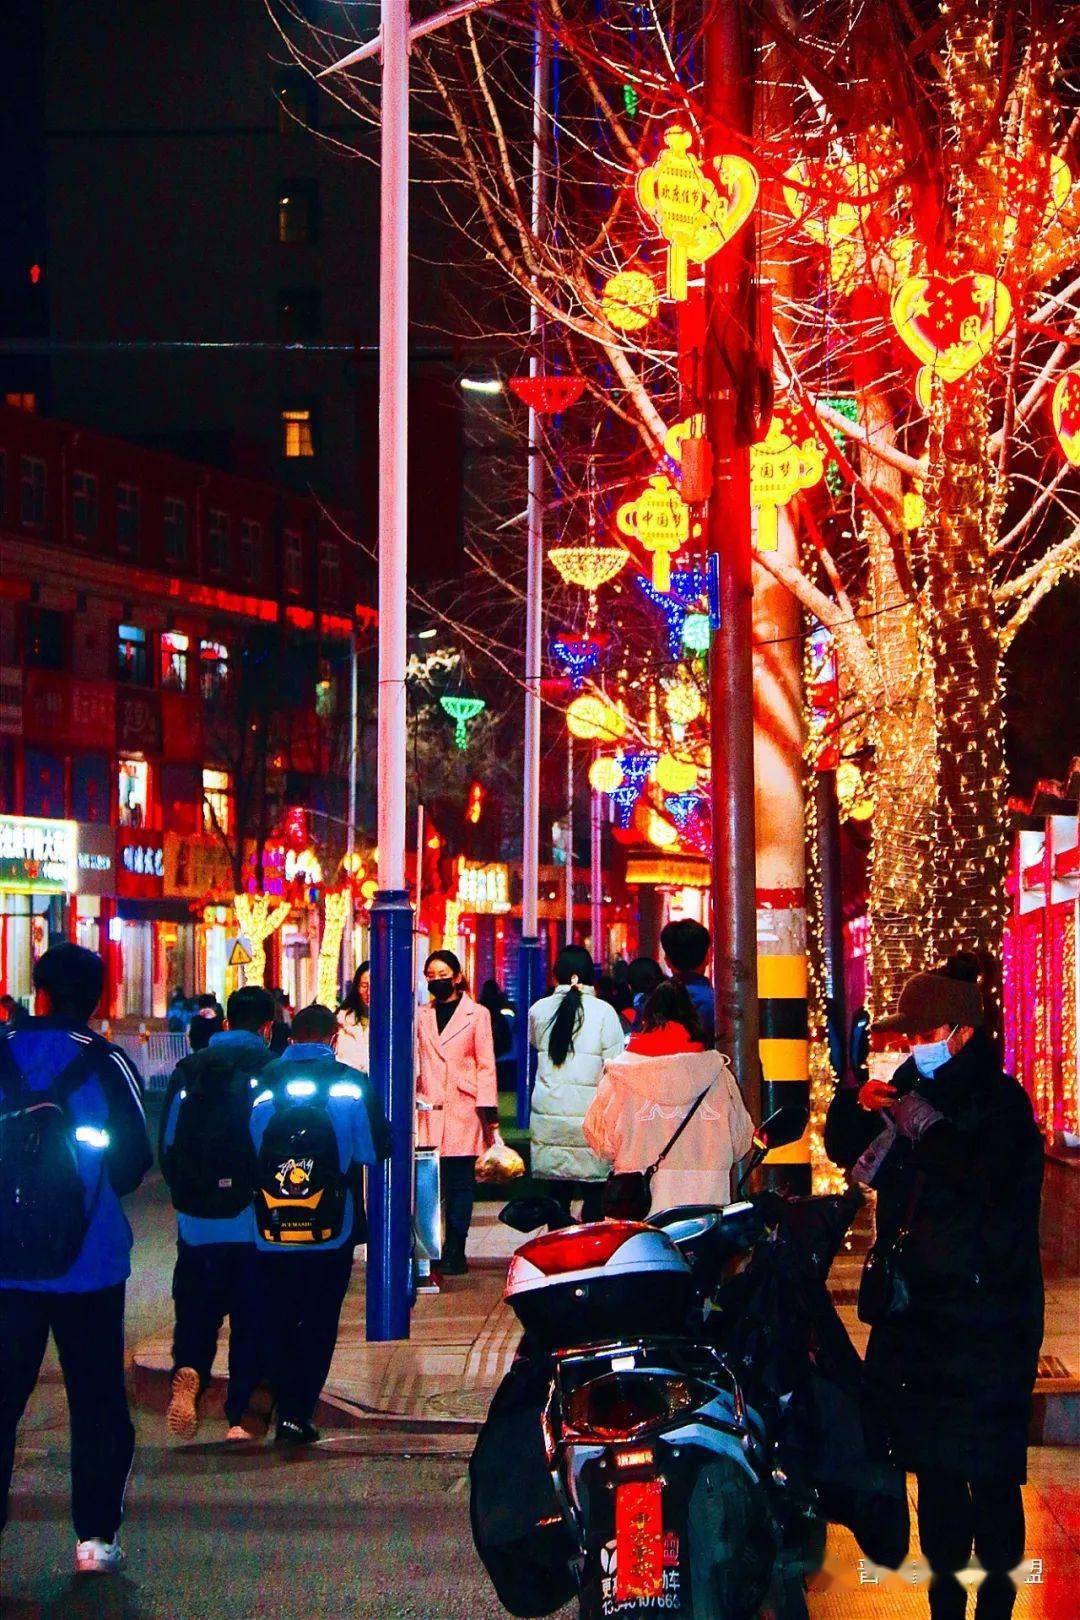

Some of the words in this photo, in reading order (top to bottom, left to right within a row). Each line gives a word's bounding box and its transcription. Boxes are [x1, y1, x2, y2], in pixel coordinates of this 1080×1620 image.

[750, 461, 790, 479] 国梦
[642, 510, 681, 528] 中国梦
